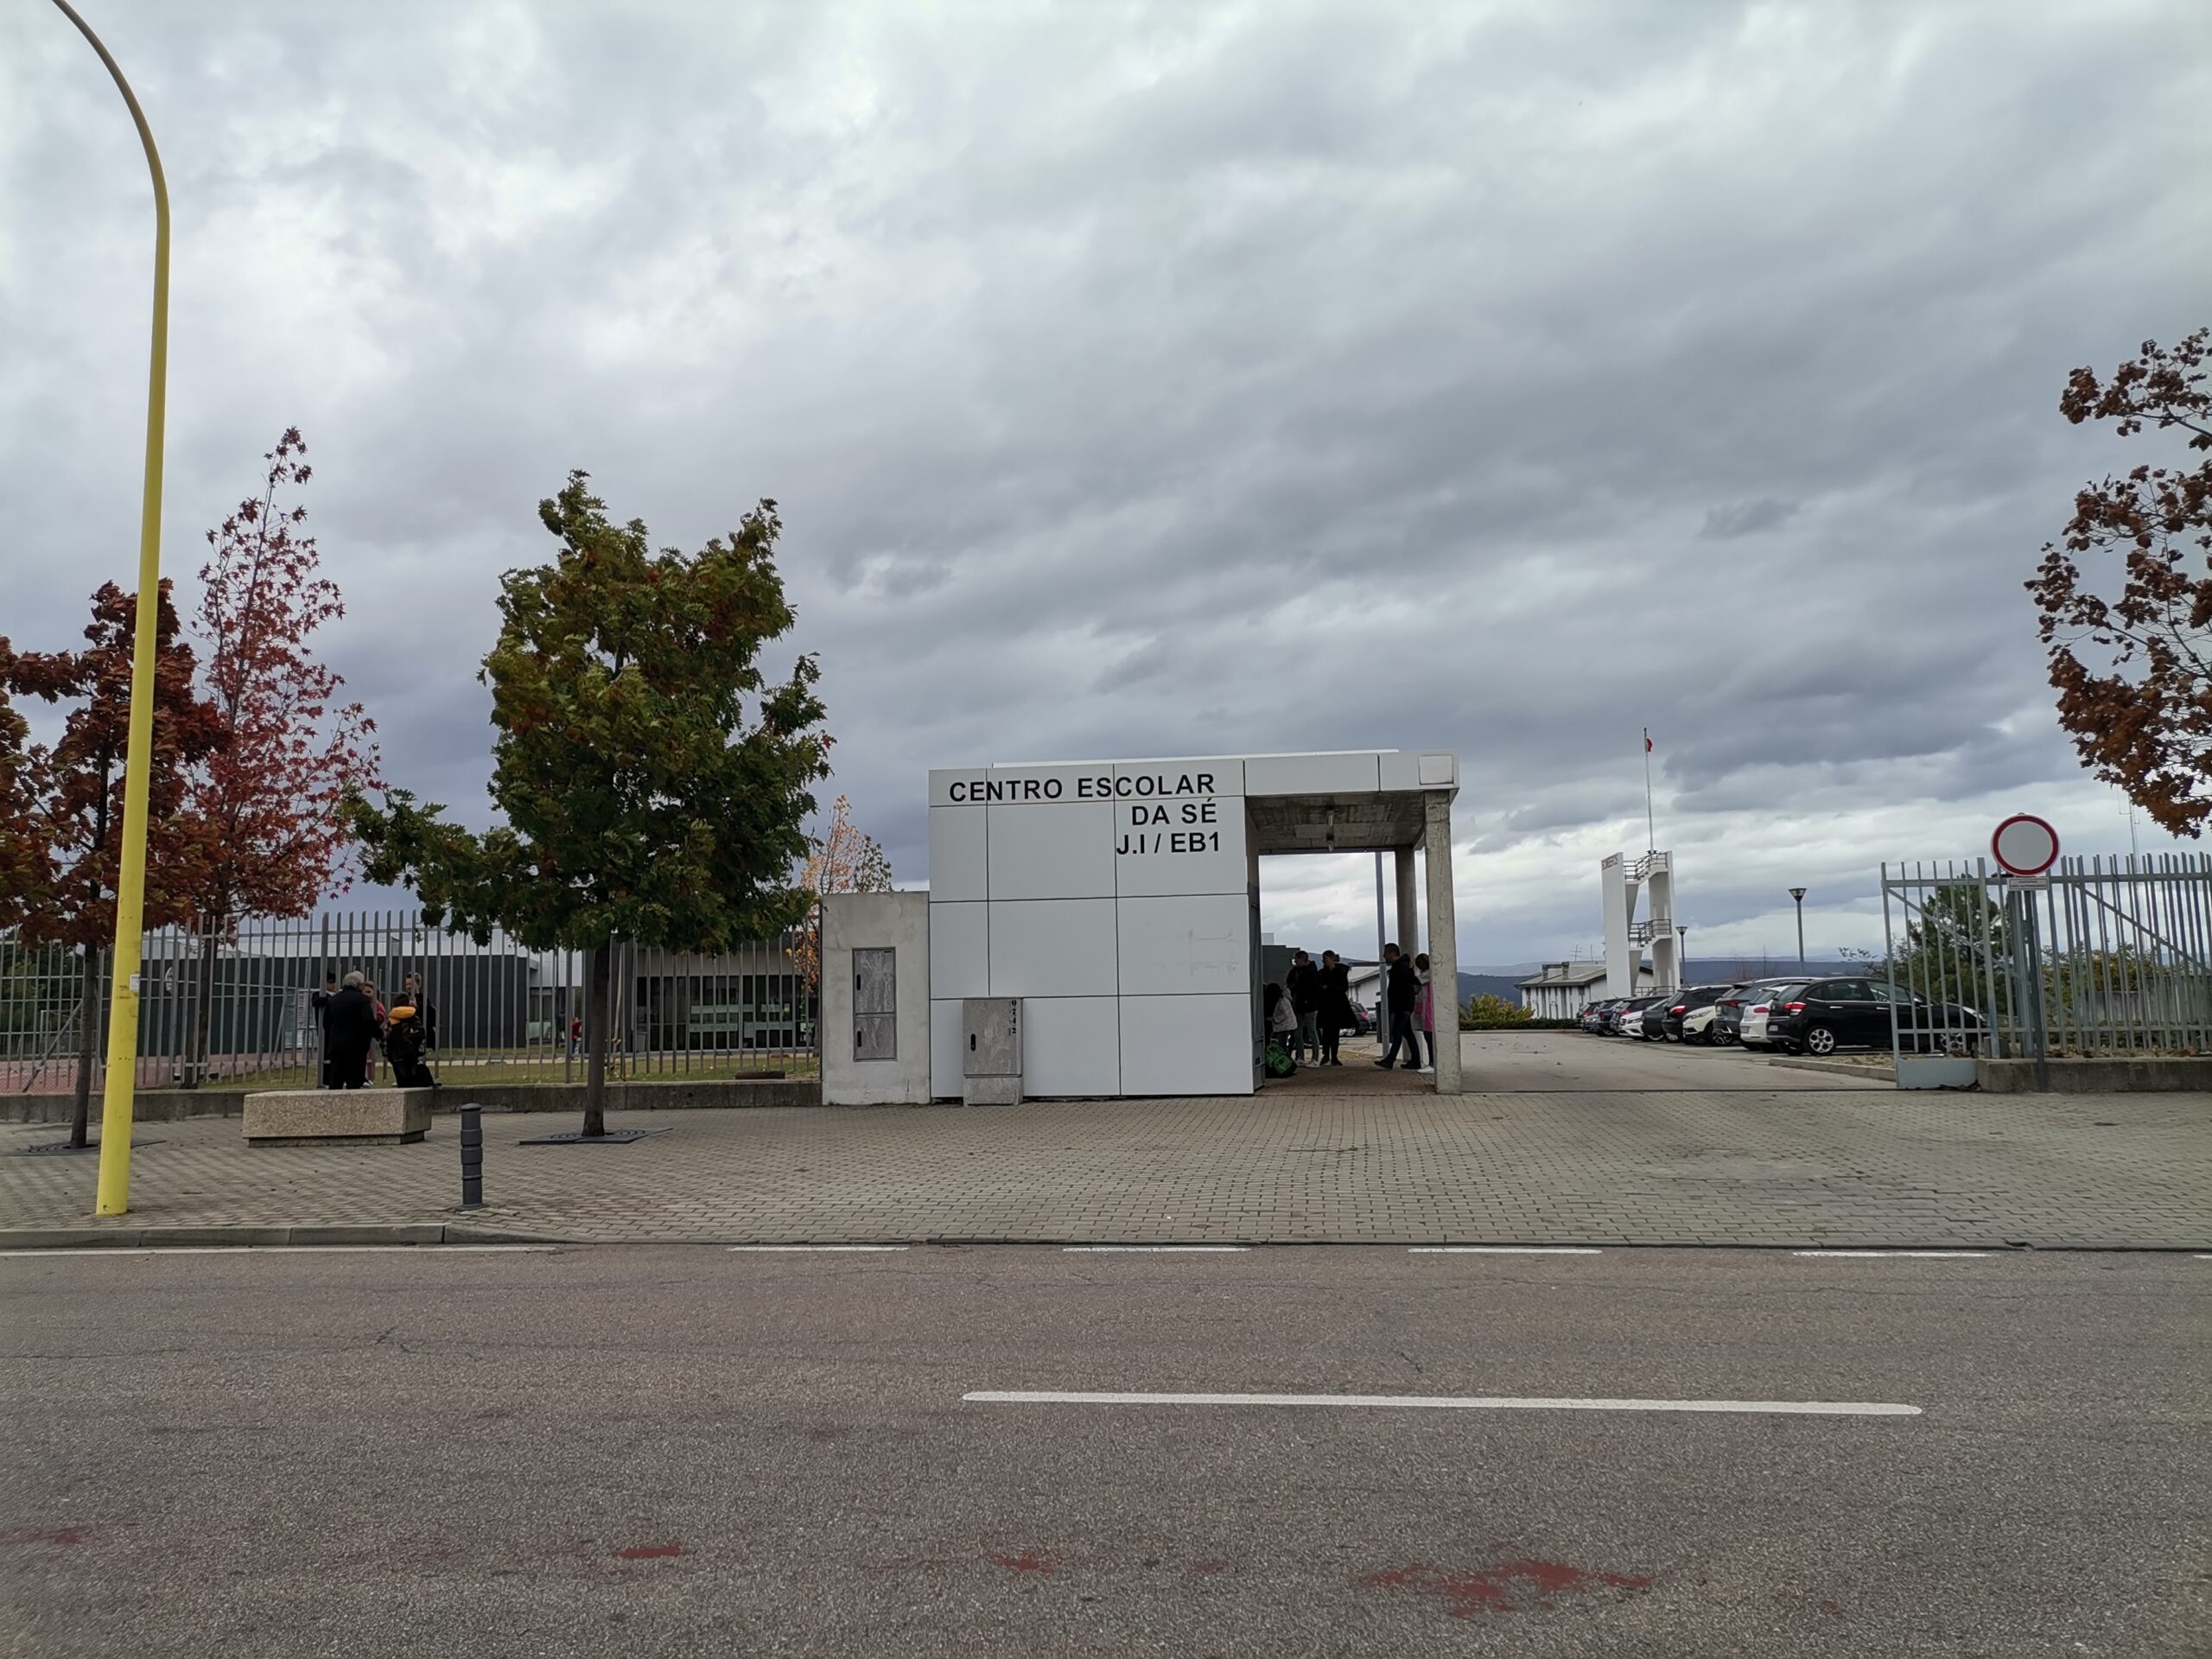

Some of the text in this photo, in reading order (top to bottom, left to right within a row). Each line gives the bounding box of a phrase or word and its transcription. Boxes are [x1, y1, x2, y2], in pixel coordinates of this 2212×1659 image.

[949, 774, 1216, 802] CENTRO ESCOLAR
[1131, 798, 1217, 826] DA SÉ
[1116, 831, 1219, 855] J.I / EB1
